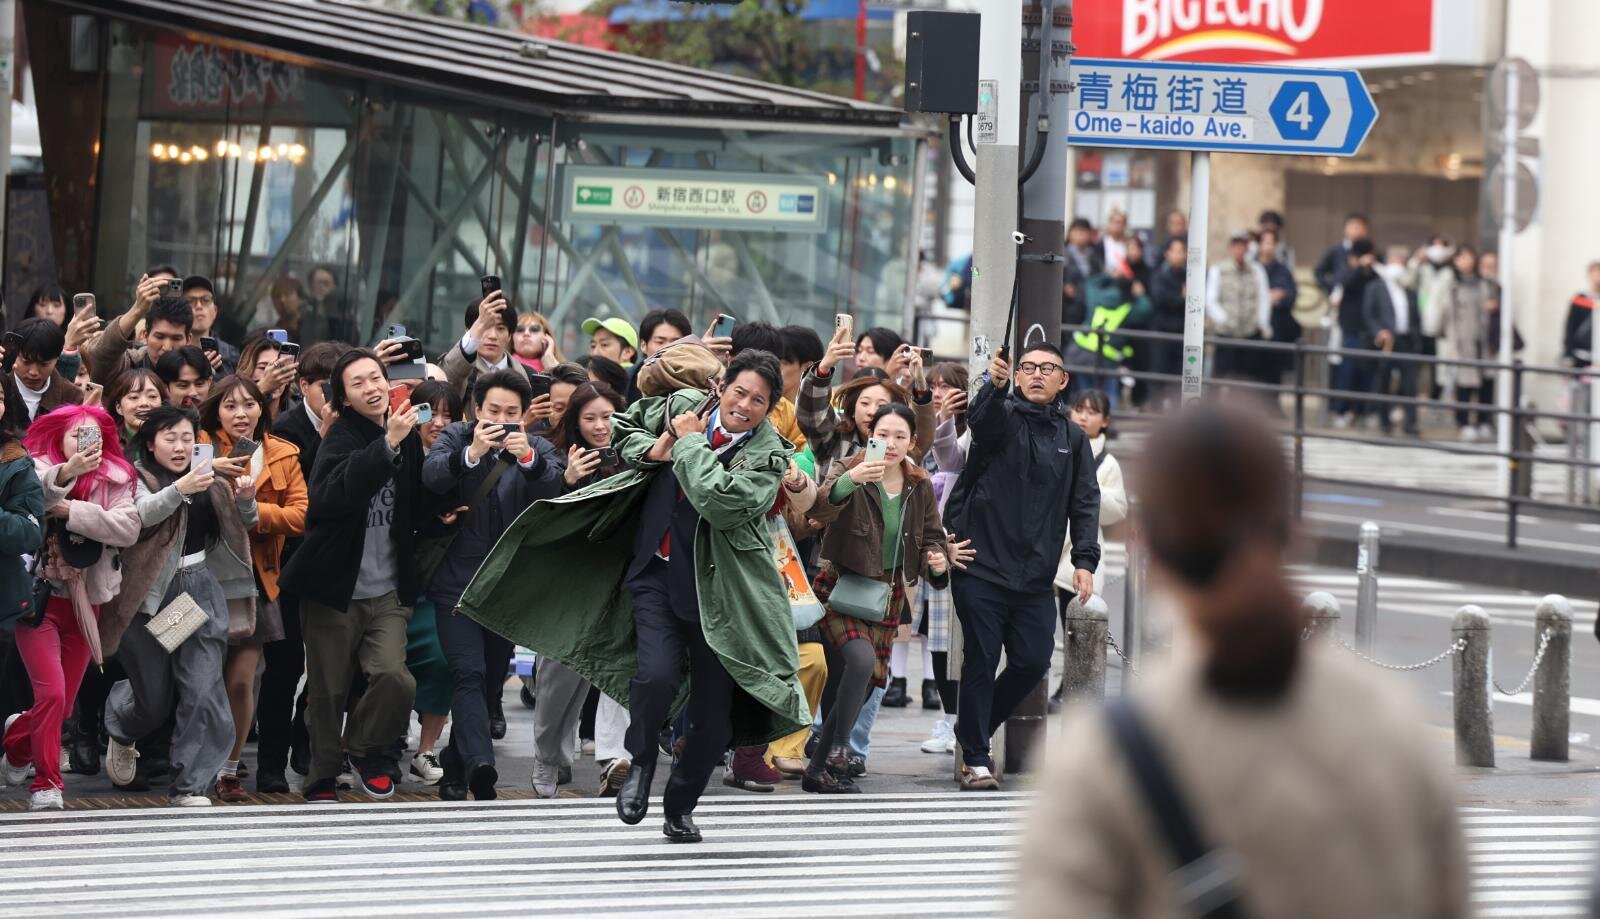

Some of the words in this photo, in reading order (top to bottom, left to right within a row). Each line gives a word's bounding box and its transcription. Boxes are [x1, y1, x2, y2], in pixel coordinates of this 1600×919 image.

[1076, 71, 1248, 116] 青梅街道
[1285, 91, 1314, 131] 4
[1203, 117, 1247, 139] Ave.
[656, 186, 736, 205] 新宿西口駅
